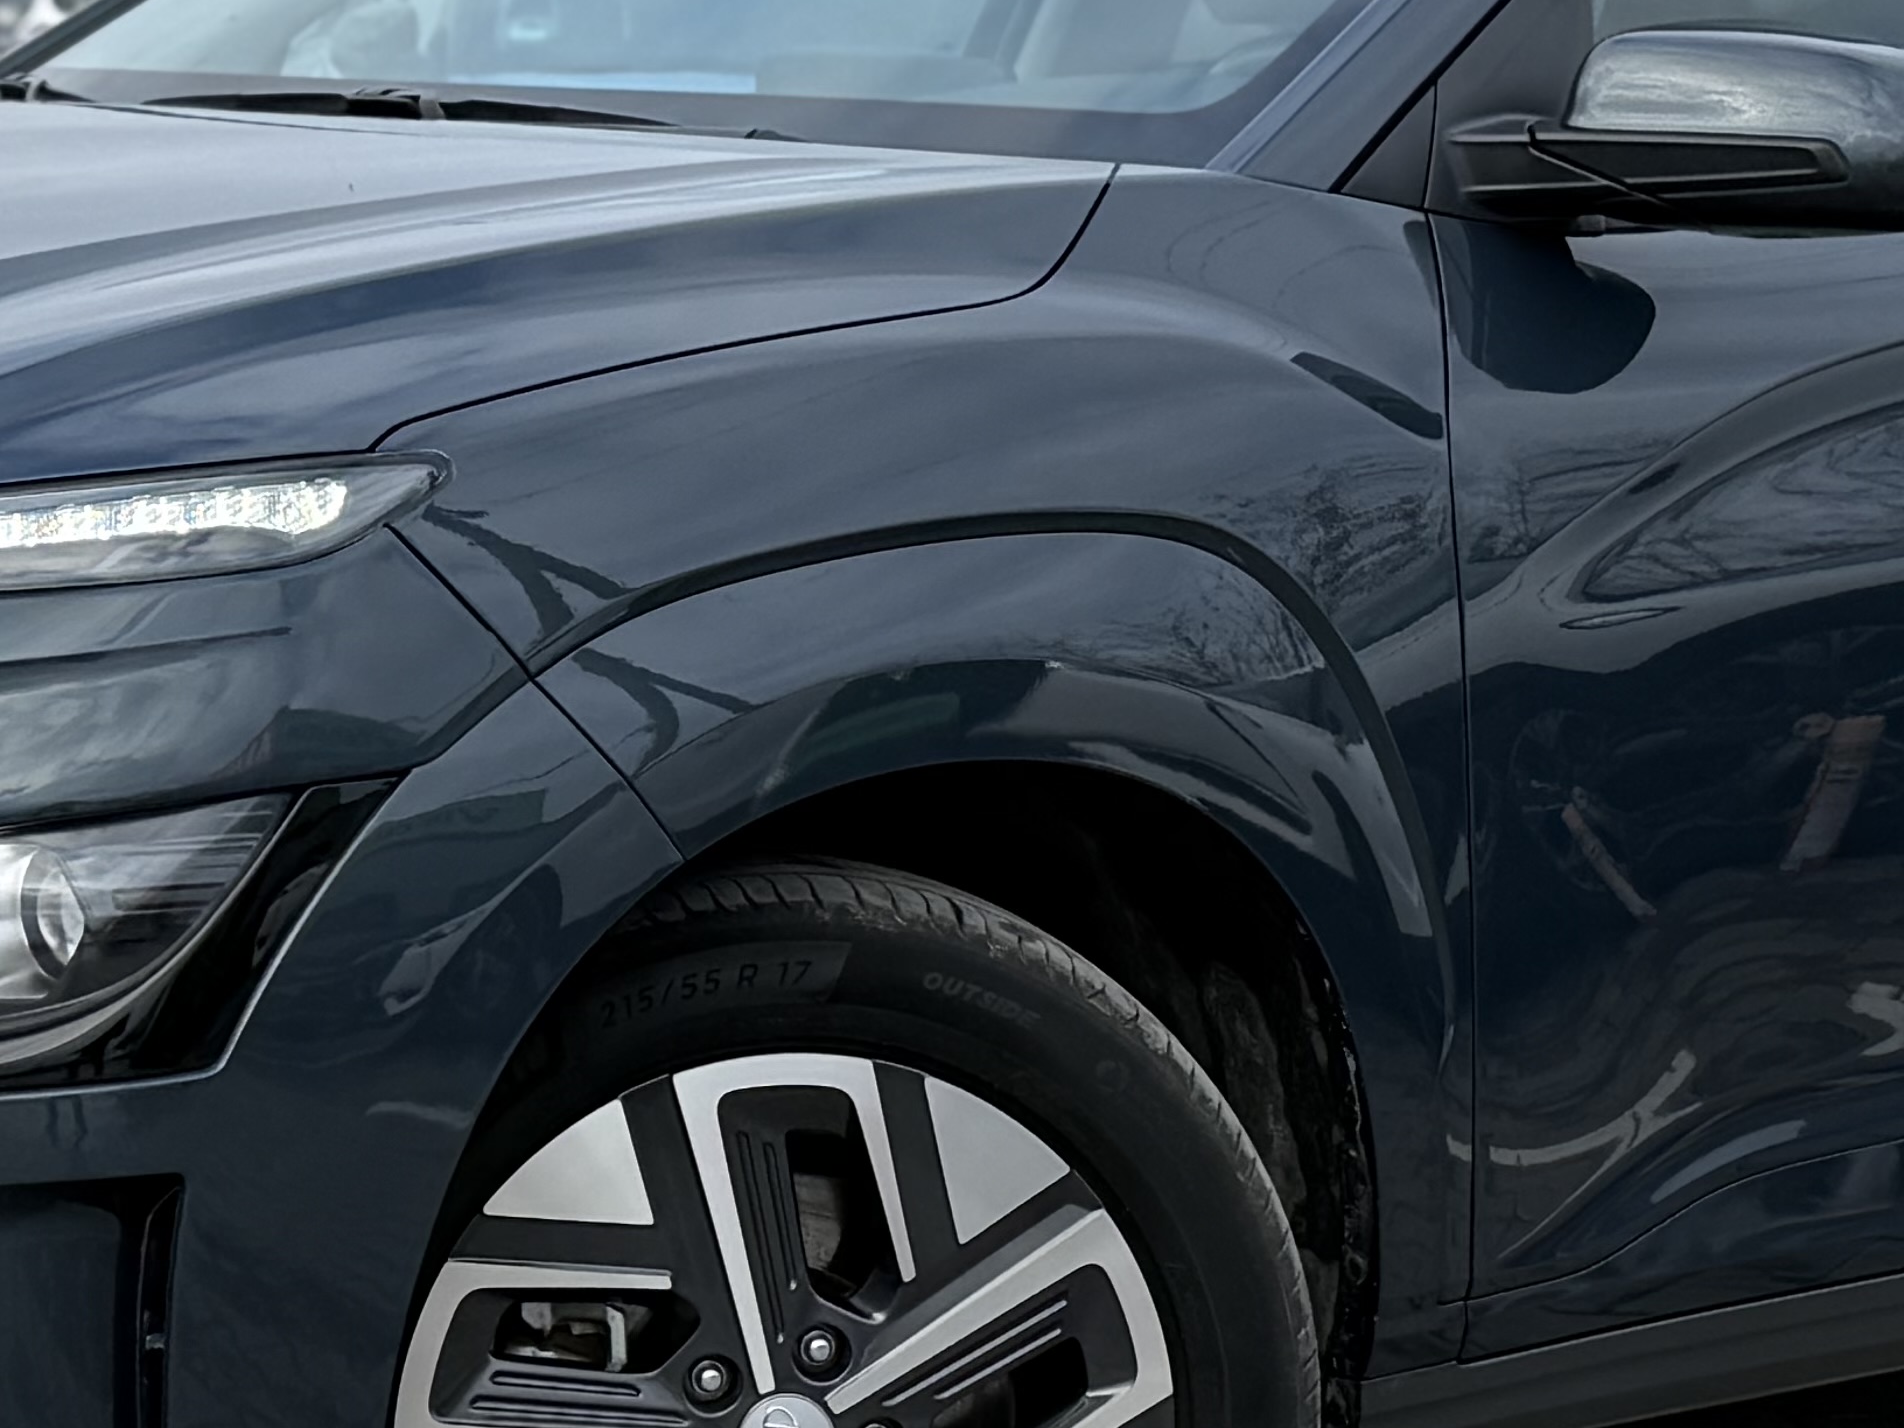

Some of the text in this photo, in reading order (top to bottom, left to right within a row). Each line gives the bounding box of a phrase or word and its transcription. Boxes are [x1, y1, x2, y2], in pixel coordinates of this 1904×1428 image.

[600, 960, 814, 1029] 215/55 R 17
[922, 971, 1043, 1031] OUTSIDE
